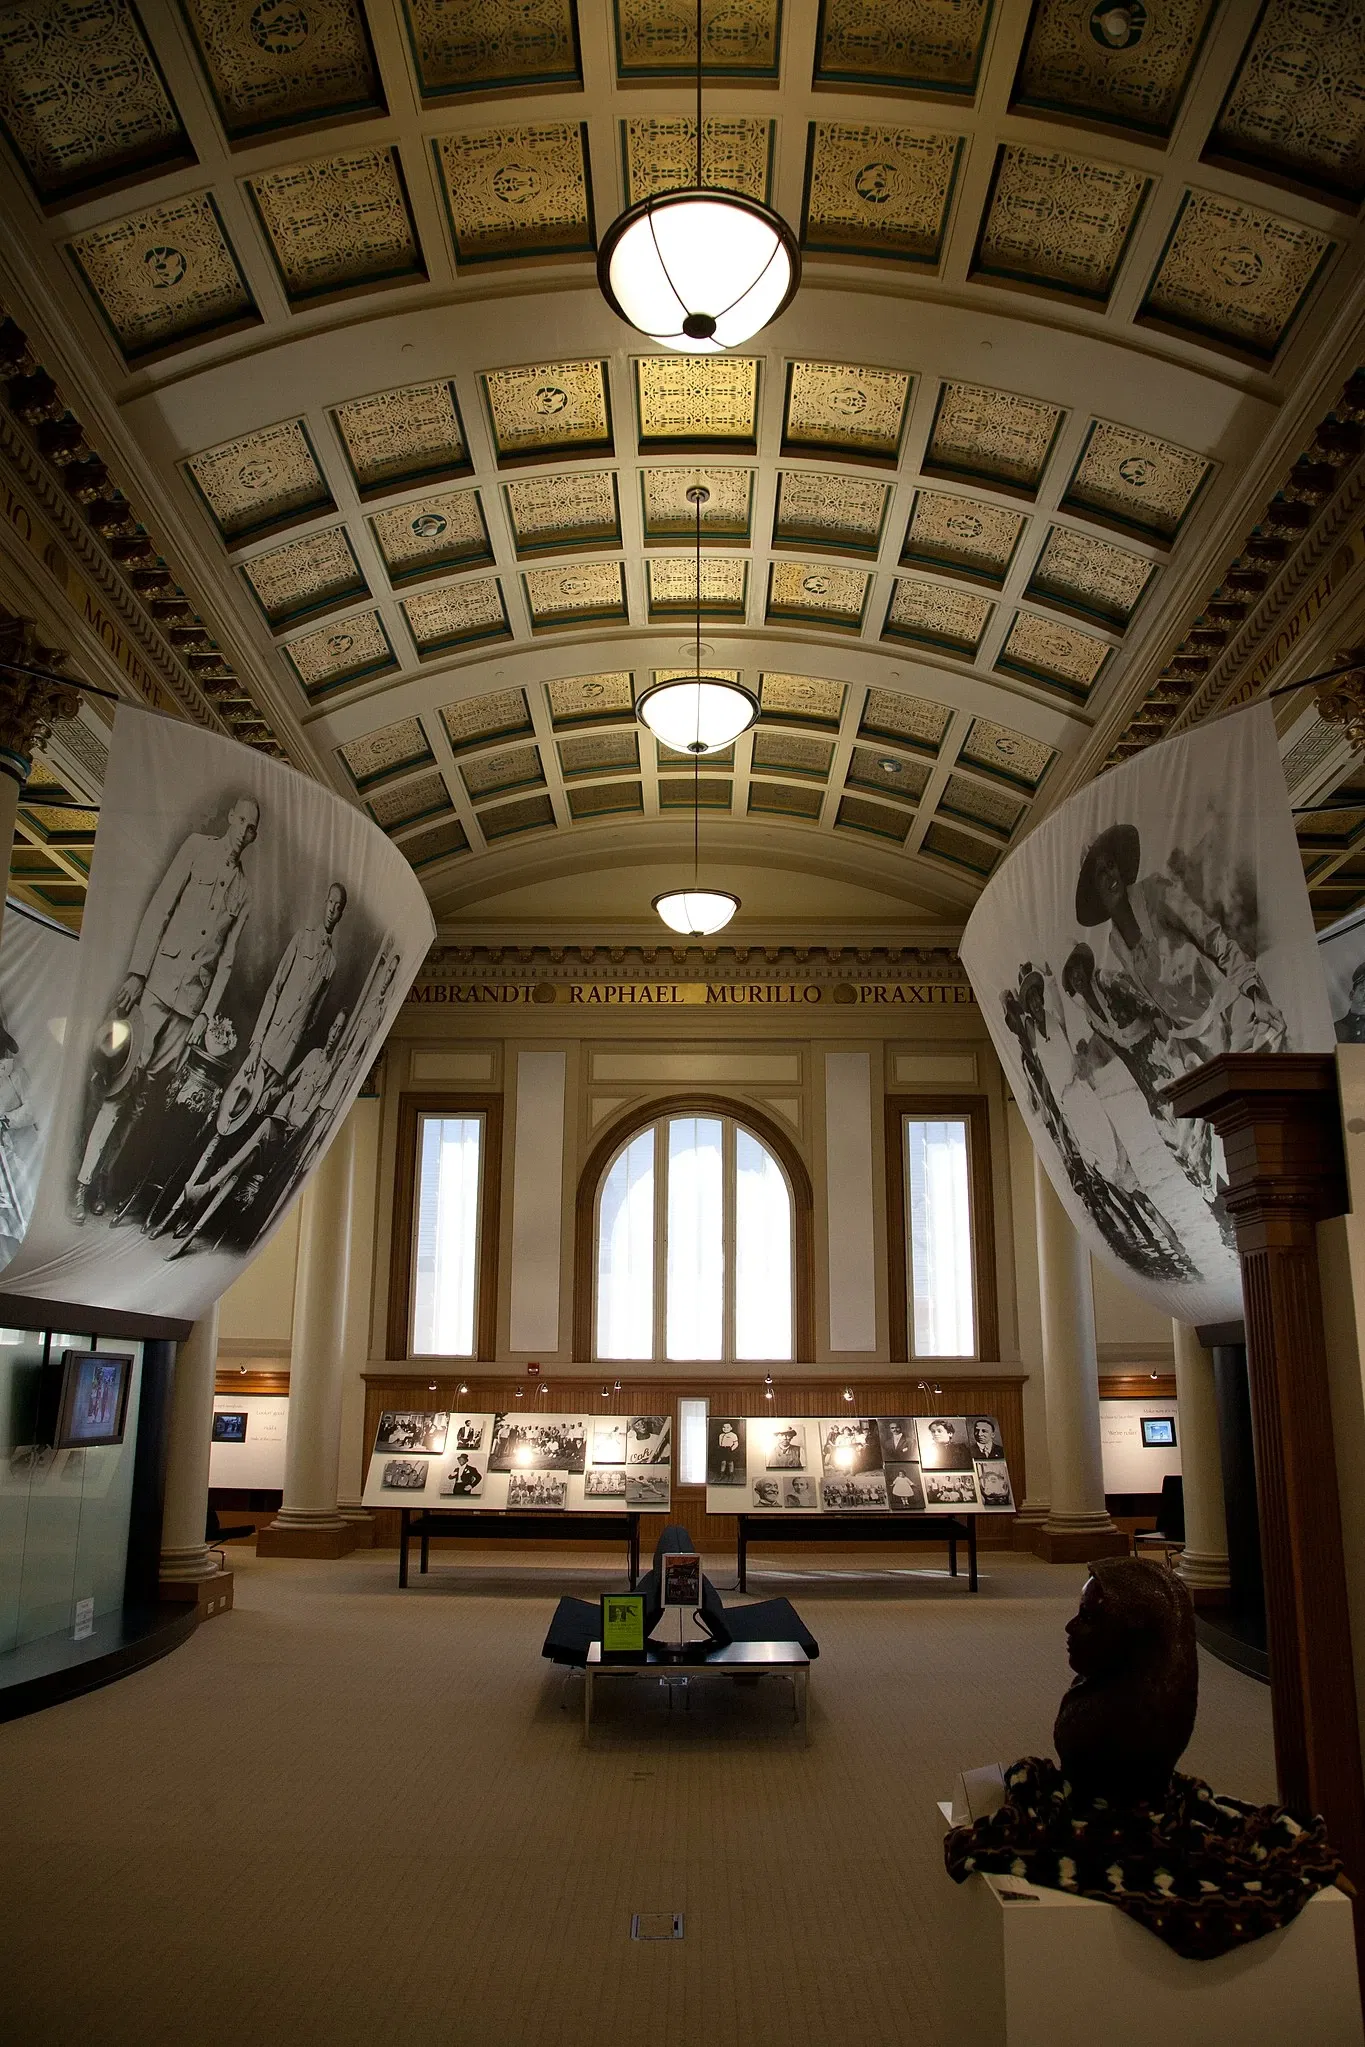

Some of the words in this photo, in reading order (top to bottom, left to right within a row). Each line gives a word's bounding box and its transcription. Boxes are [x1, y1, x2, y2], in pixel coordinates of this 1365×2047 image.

[404, 985, 536, 1003] MBRANDT
[569, 985, 684, 1003] RAPHAEL
[704, 985, 822, 1003] MURILLO
